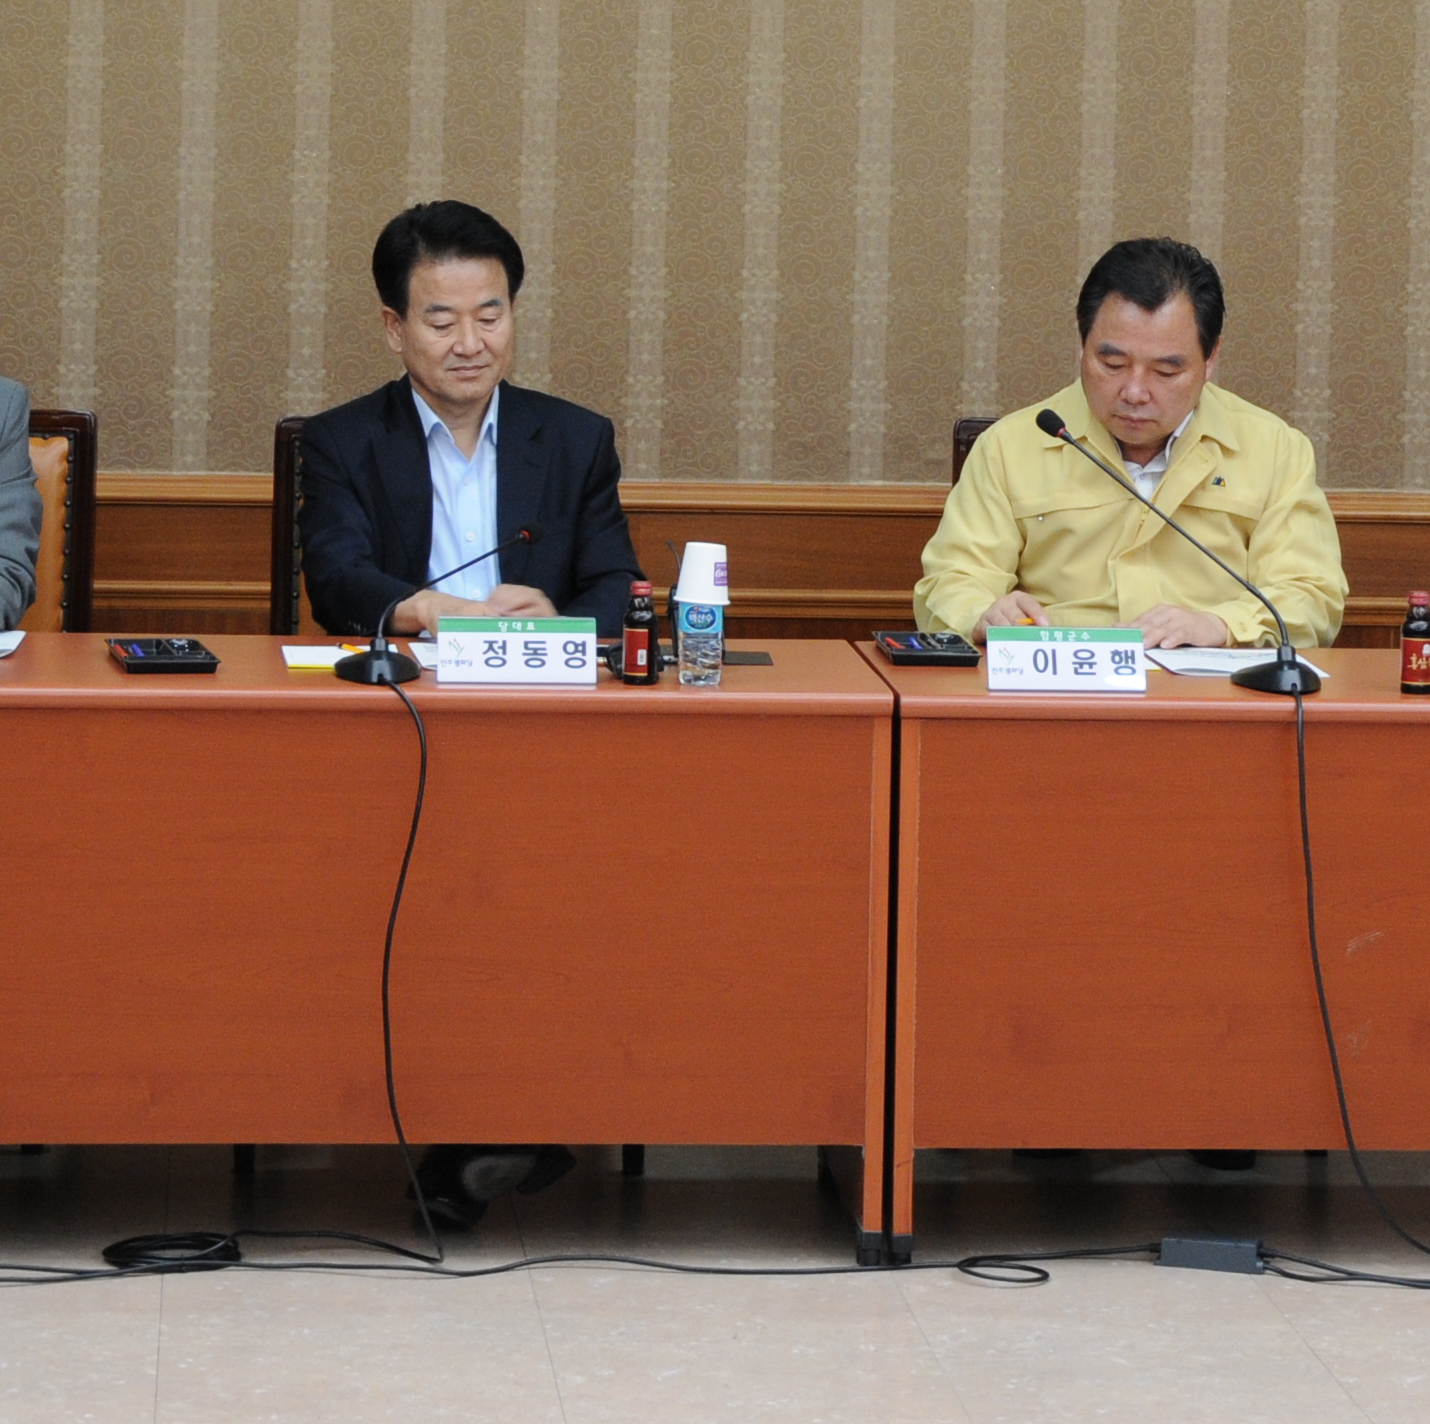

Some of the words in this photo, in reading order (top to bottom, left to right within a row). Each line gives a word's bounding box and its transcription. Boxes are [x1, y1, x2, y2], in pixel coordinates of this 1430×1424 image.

[1039, 630, 1091, 642] 함평군수
[482, 639, 587, 669] 정동영
[1032, 648, 1137, 676] 이윤행
